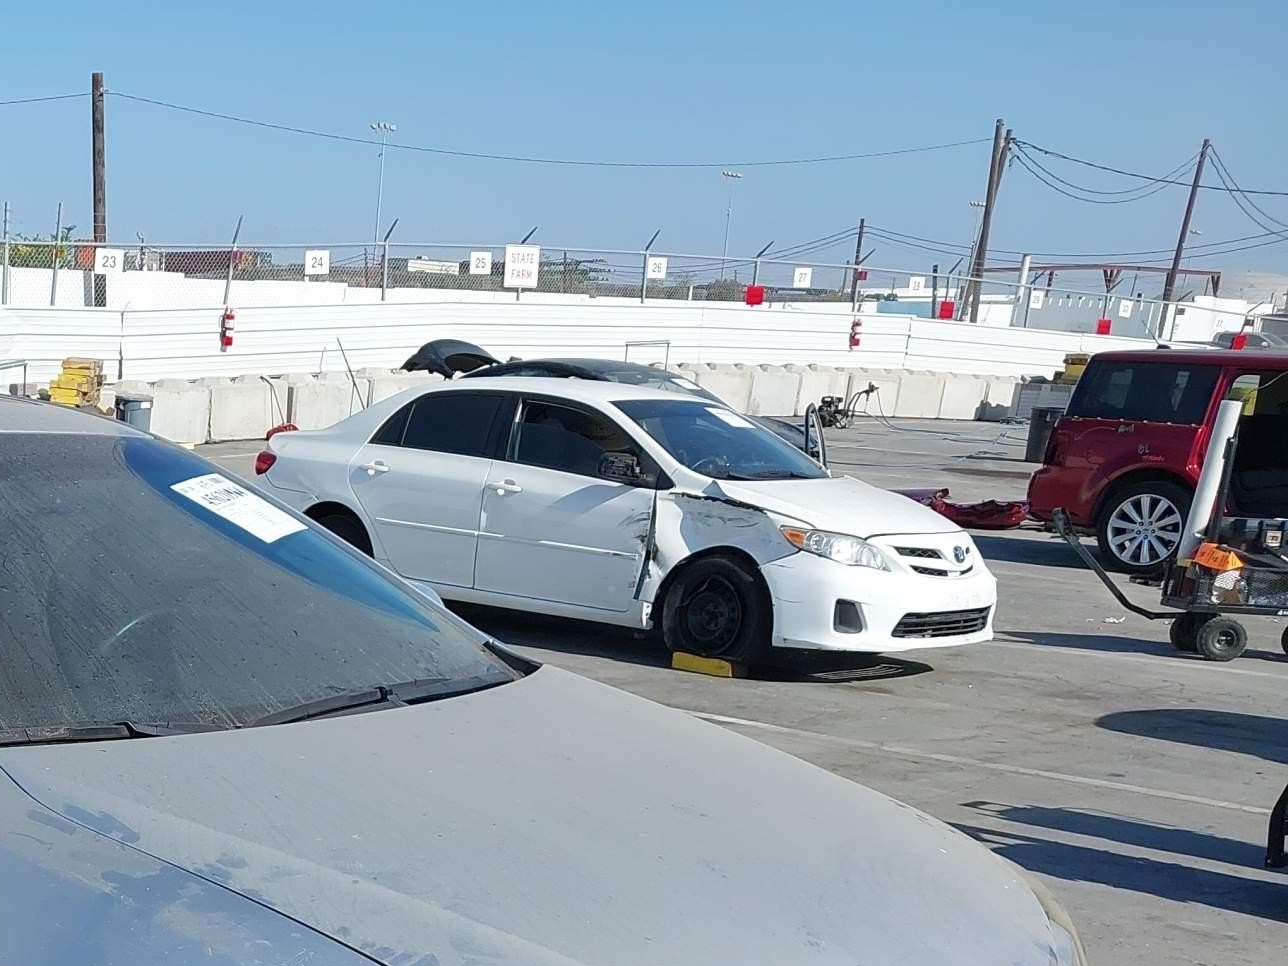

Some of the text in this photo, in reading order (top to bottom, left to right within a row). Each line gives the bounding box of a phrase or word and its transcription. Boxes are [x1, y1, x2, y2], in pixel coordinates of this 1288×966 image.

[101, 255, 117, 269] 23
[311, 256, 323, 269] 24
[475, 257, 487, 269] 25
[511, 252, 535, 264] STATE
[652, 262, 662, 273] 26
[510, 268, 533, 280] FARM
